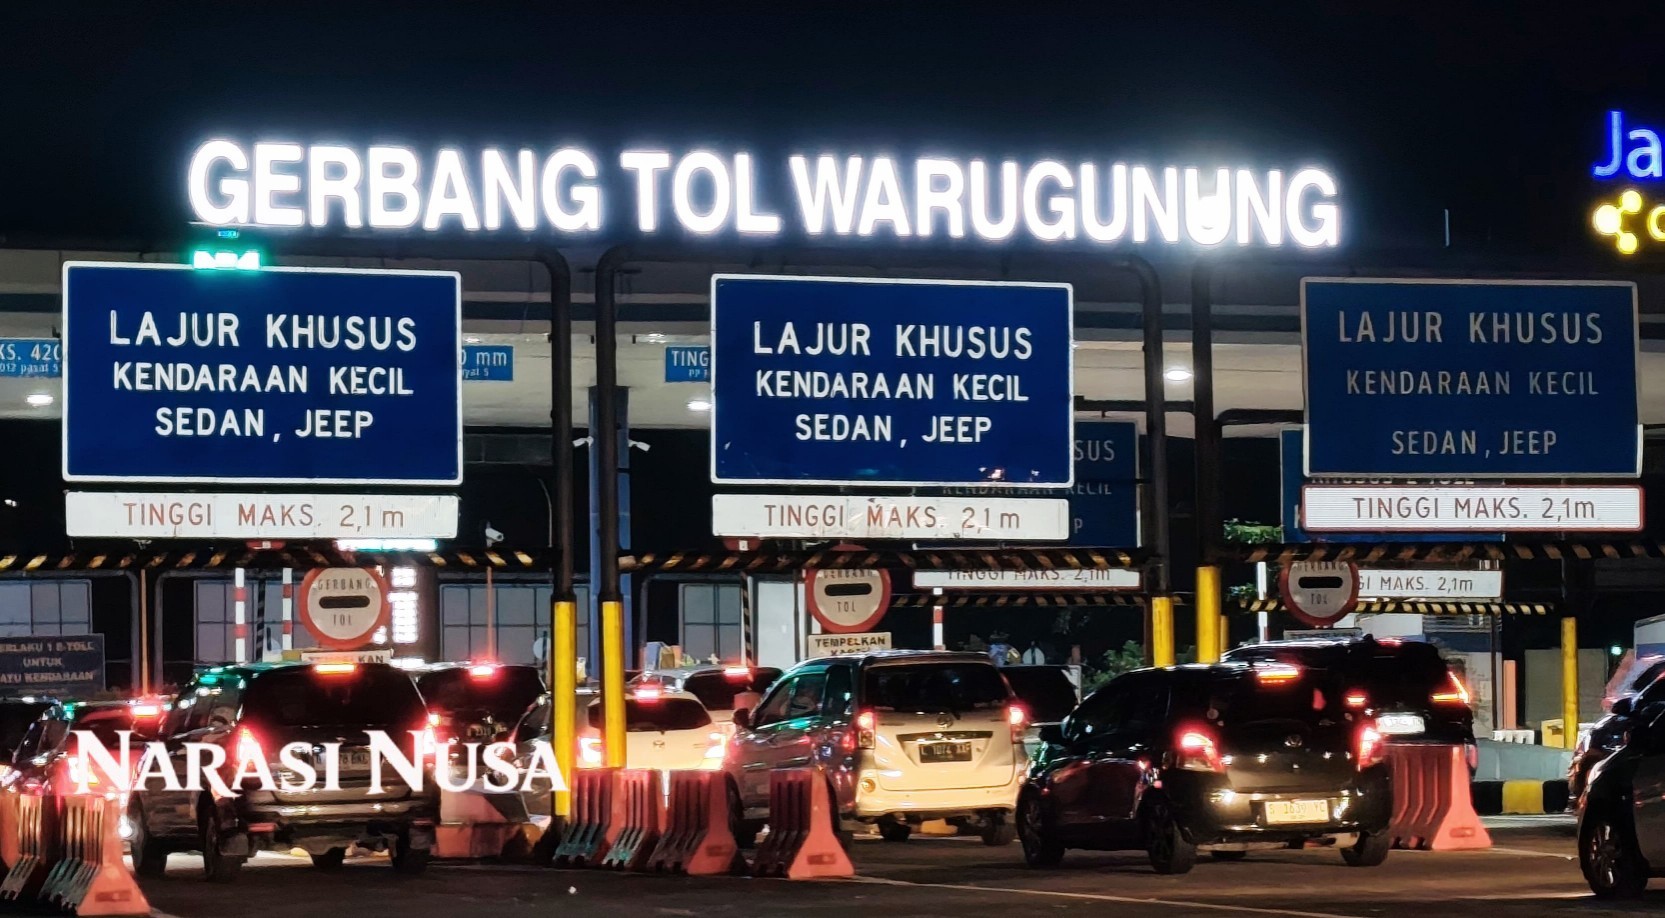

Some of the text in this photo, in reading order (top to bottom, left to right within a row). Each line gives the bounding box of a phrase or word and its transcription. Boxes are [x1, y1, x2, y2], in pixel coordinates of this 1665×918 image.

[188, 139, 1338, 247] GERBANG TOL WARUGUNUNG
[110, 310, 417, 352] LAJUR KHUSUS
[753, 320, 1032, 360] LAJUR KHUSUS
[1338, 310, 1603, 344] LAJUR KHUSUS
[476, 351, 507, 367] mm
[113, 361, 414, 395] KENDARAAN KECIL
[756, 370, 1029, 402] KENDARAAN KECIL
[1347, 370, 1599, 395] KENDARAAN KECIL
[295, 409, 374, 438] JEEP
[922, 415, 992, 443] JEEP
[1499, 430, 1557, 455] JEEP
[123, 502, 212, 527] TINGGI
[238, 503, 321, 527] MAKS.
[764, 504, 844, 527] TINGGI
[1352, 496, 1595, 523] TINGGI MAKS. 2,1m
[317, 578, 372, 591] GERBANG
[837, 601, 856, 613] TOL
[815, 636, 886, 648] TEMPELKAN
